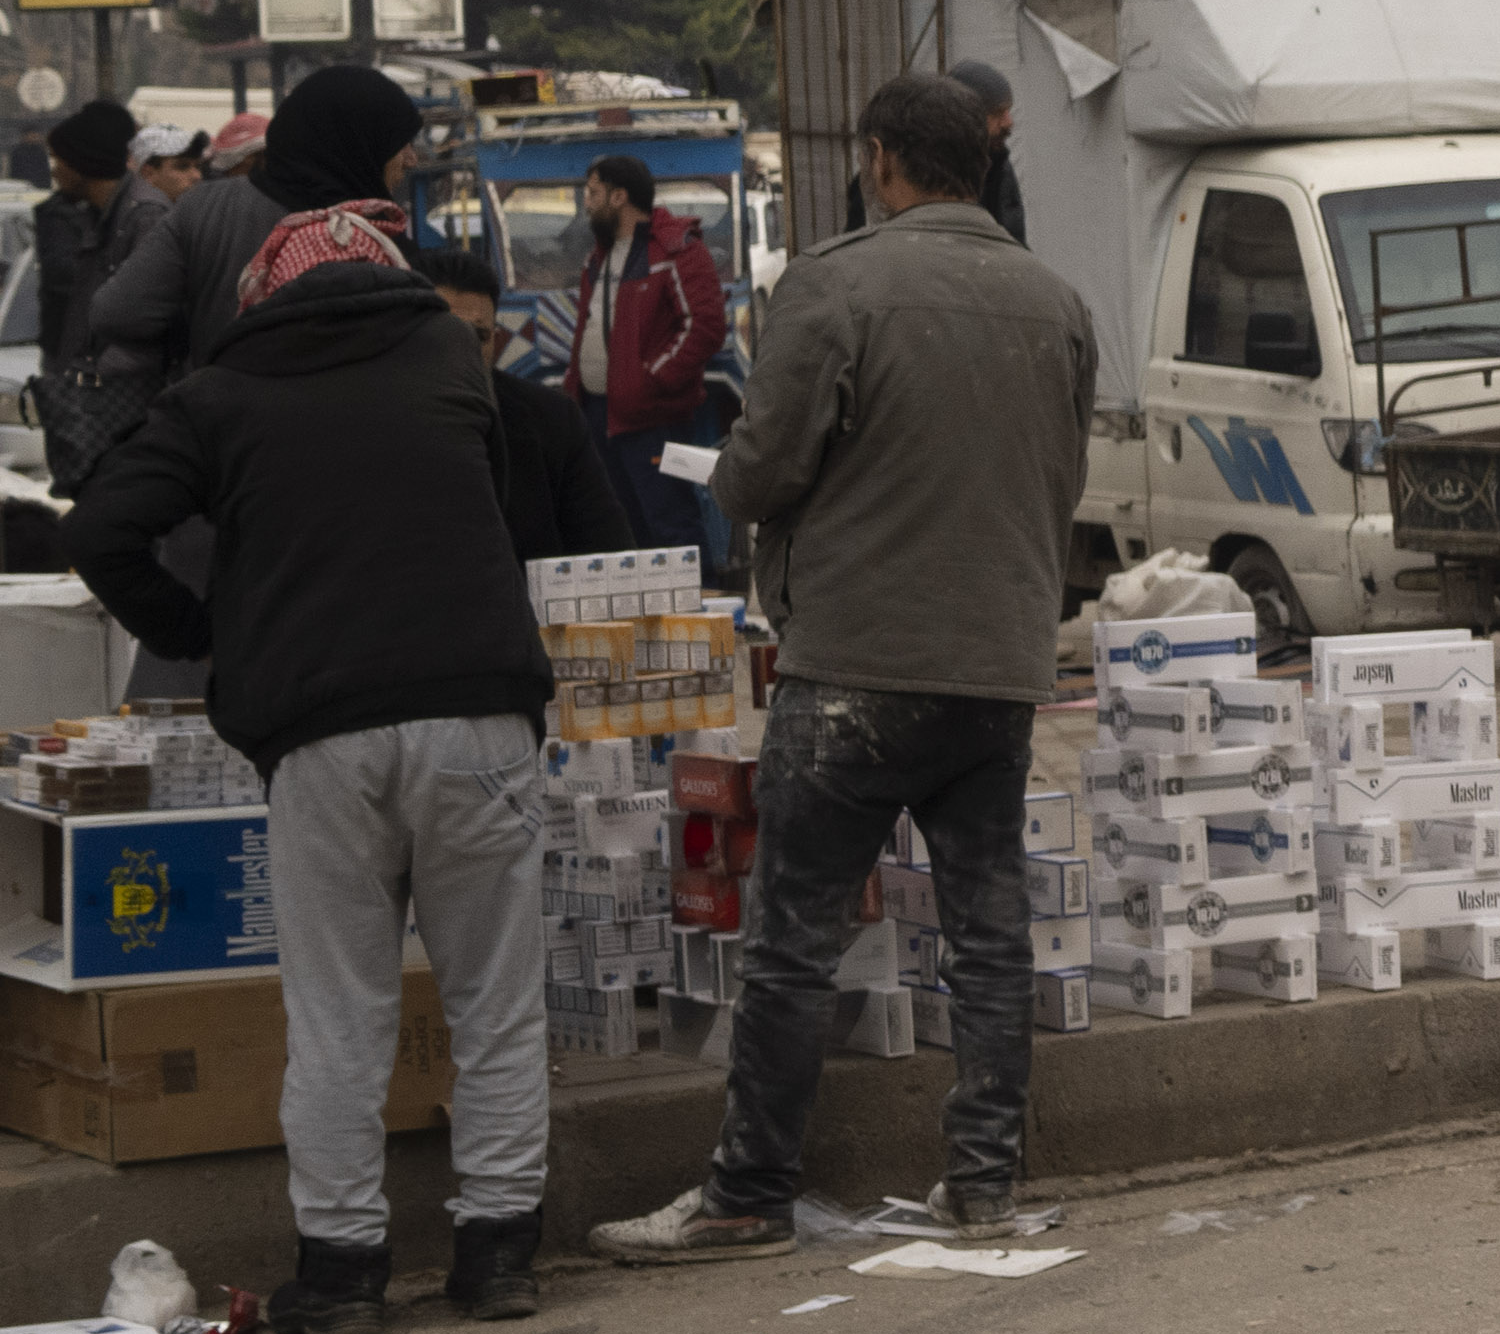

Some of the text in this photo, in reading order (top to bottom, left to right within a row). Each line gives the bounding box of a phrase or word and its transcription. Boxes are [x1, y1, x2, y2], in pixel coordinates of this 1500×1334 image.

[1140, 644, 1163, 660] 1970
[1353, 664, 1395, 685] Master
[1449, 782, 1494, 804] Master
[596, 795, 667, 815] CARMEN
[226, 828, 281, 958] Manchester
[1196, 906, 1220, 923] 1970
[399, 1027, 413, 1066] ONLY
[415, 1015, 431, 1075] EXPORT
